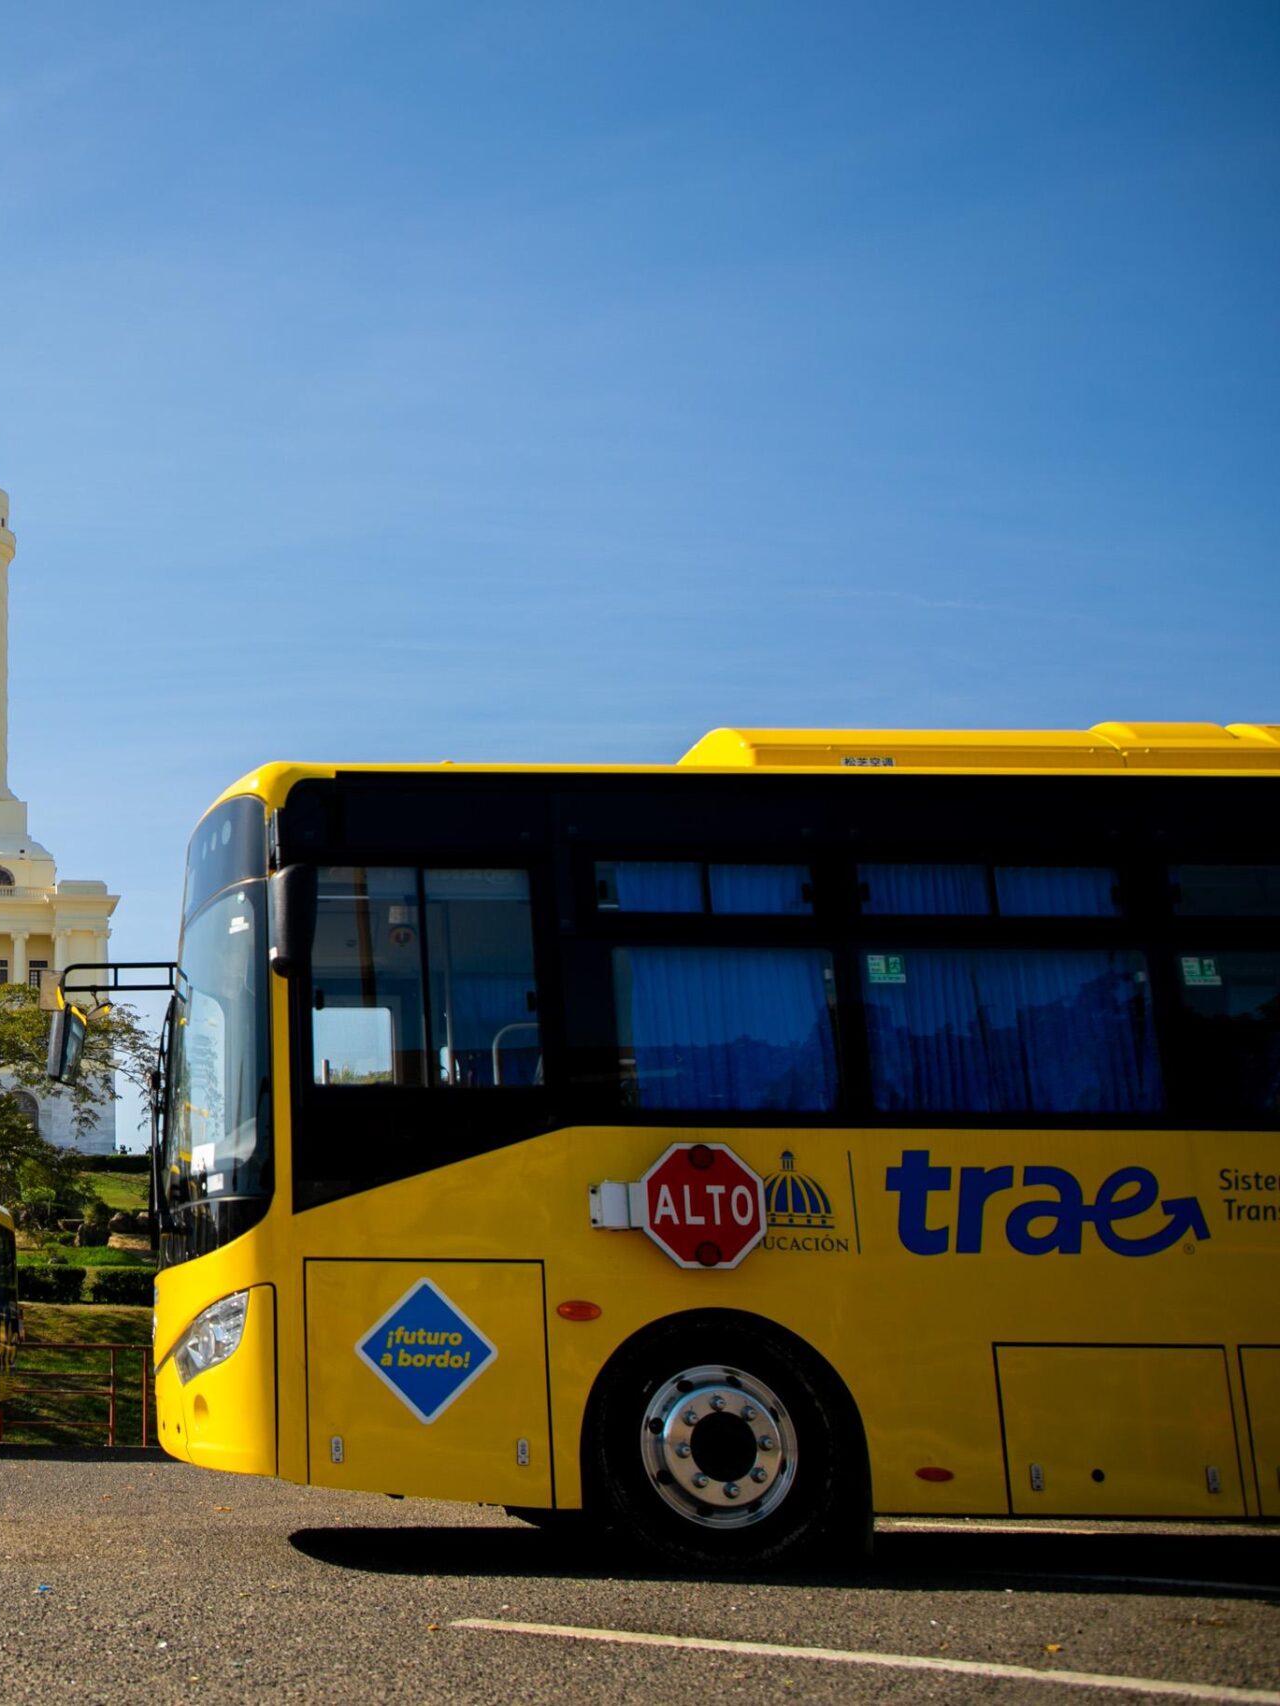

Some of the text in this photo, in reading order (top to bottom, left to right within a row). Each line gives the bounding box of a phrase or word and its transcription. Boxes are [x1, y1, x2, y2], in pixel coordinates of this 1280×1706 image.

[1219, 1168, 1280, 1191] Siste
[654, 1184, 754, 1226] ALTO
[885, 1150, 1211, 1257] trae
[1223, 1198, 1280, 1221] Tran
[387, 1326, 463, 1349] ¡futuro
[380, 1349, 470, 1368] a bordo!
